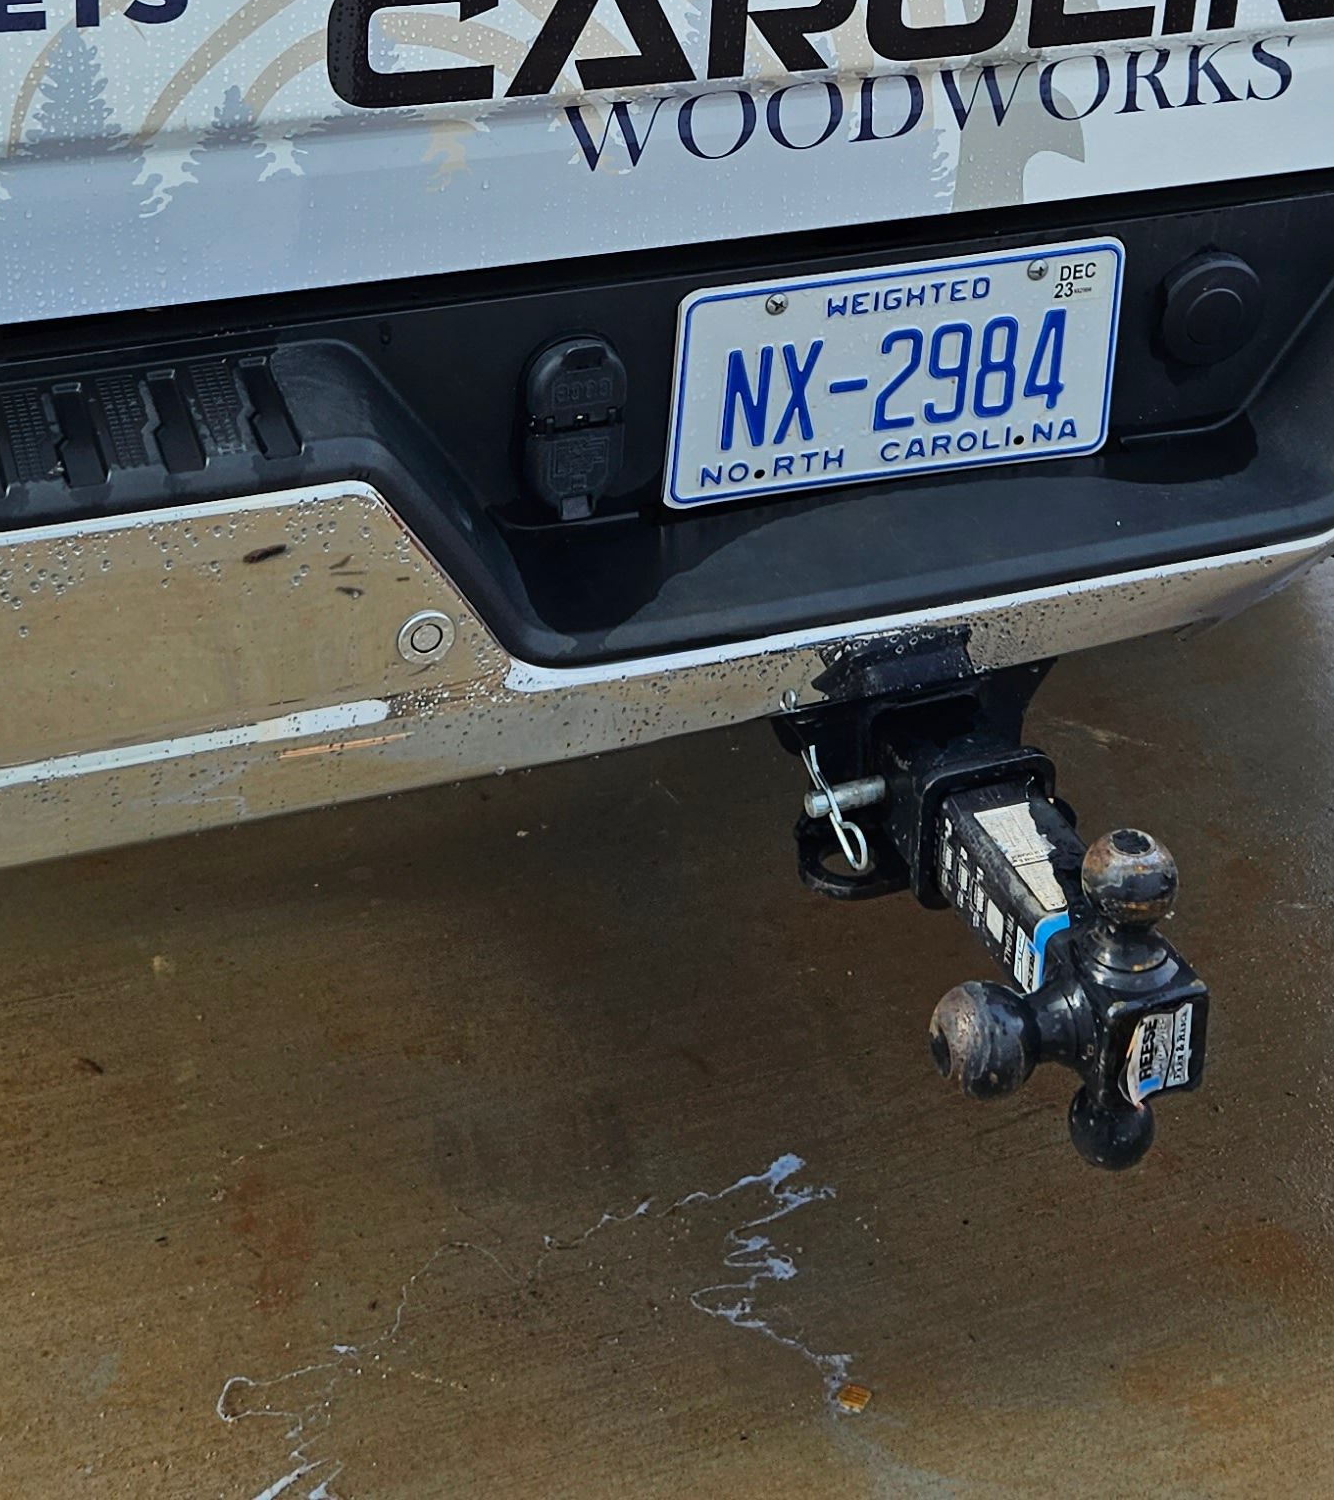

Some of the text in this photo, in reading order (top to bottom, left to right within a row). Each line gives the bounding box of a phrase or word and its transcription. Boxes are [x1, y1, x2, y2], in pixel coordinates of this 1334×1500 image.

[563, 34, 1298, 173] WOODWORKS
[827, 276, 992, 318] WEIGHTED
[1054, 281, 1074, 299] 23
[1059, 262, 1097, 282] DEC
[720, 308, 1068, 452] NX-2984
[699, 417, 1079, 489] NORTH CAROLINA
[1138, 1018, 1158, 1082] REESE
